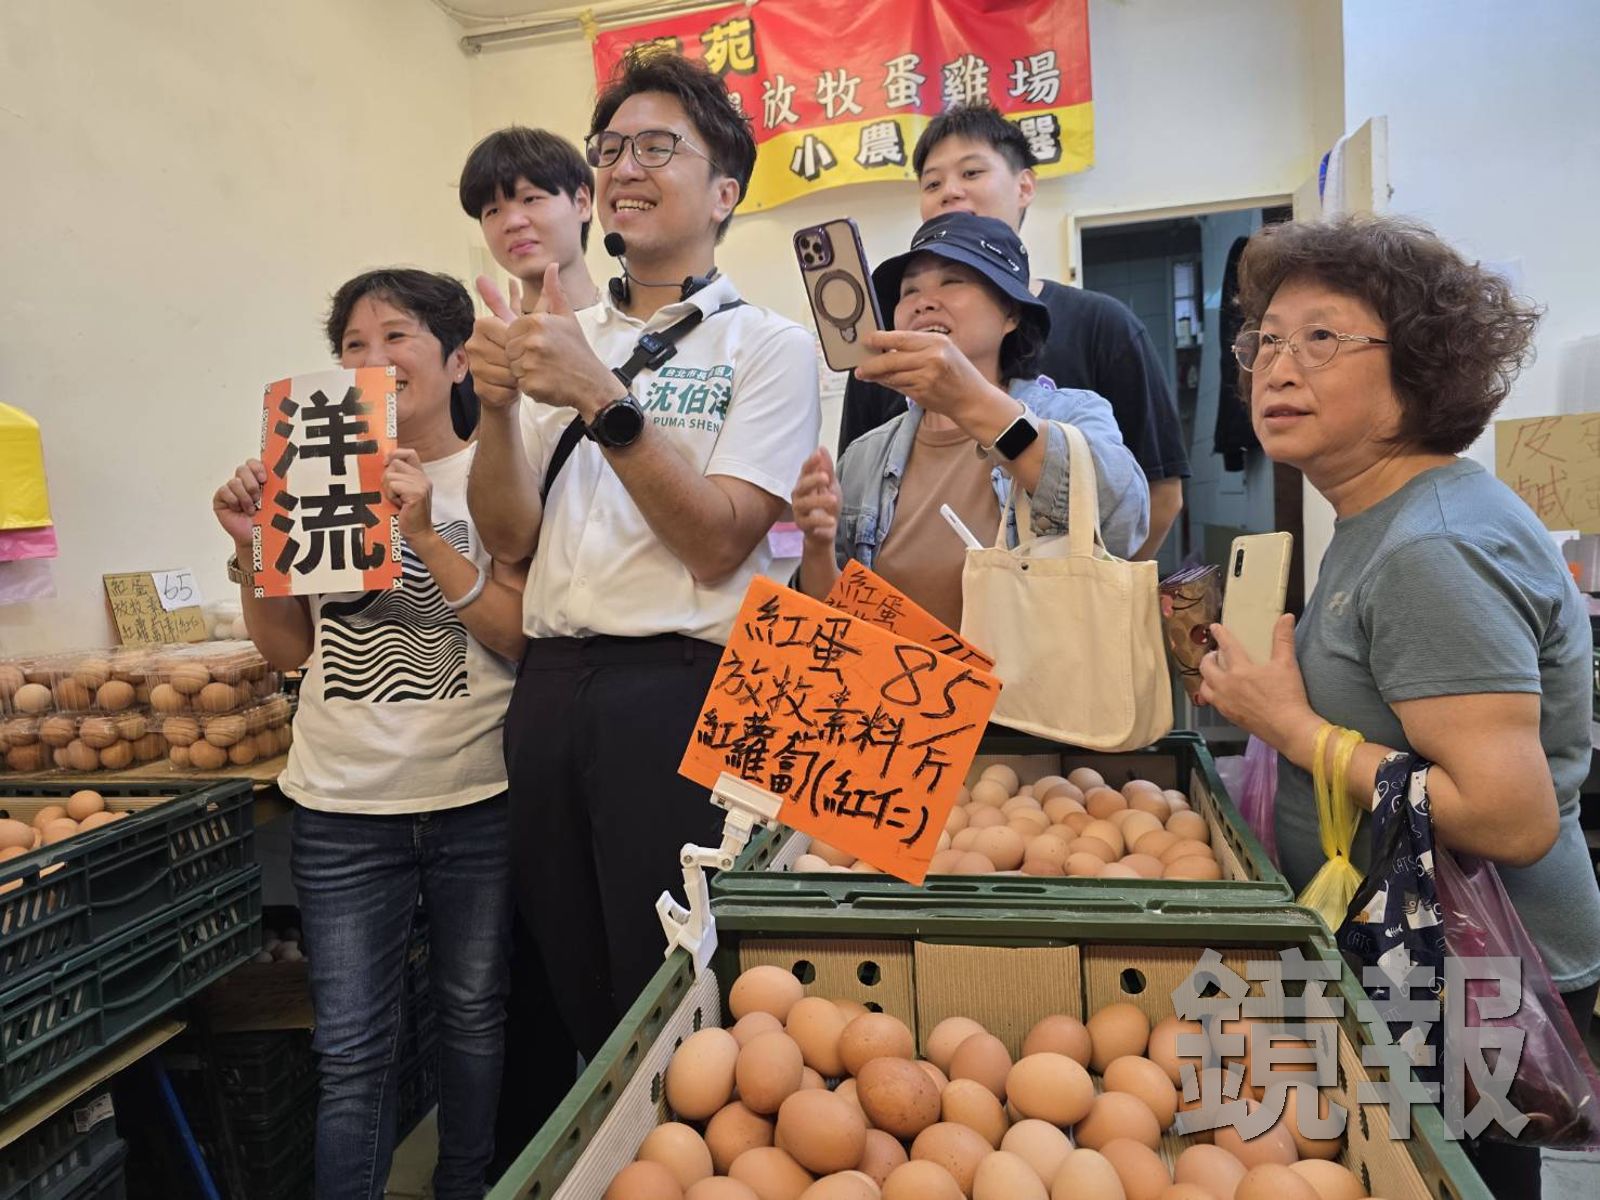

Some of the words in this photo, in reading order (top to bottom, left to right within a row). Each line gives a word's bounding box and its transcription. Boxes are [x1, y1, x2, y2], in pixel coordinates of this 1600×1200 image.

[727, 50, 1062, 128] 放牧蛋雞場
[790, 115, 1062, 180] 小農選
[653, 416, 685, 429] PUMA
[688, 418, 719, 433] SHEN
[272, 386, 385, 576] 洋流
[253, 524, 263, 571] 20261128
[390, 515, 401, 562] 20261128
[163, 573, 193, 601] 65
[840, 570, 906, 632] 紅蛋
[745, 595, 862, 685] 紅蛋
[880, 645, 990, 718] 85
